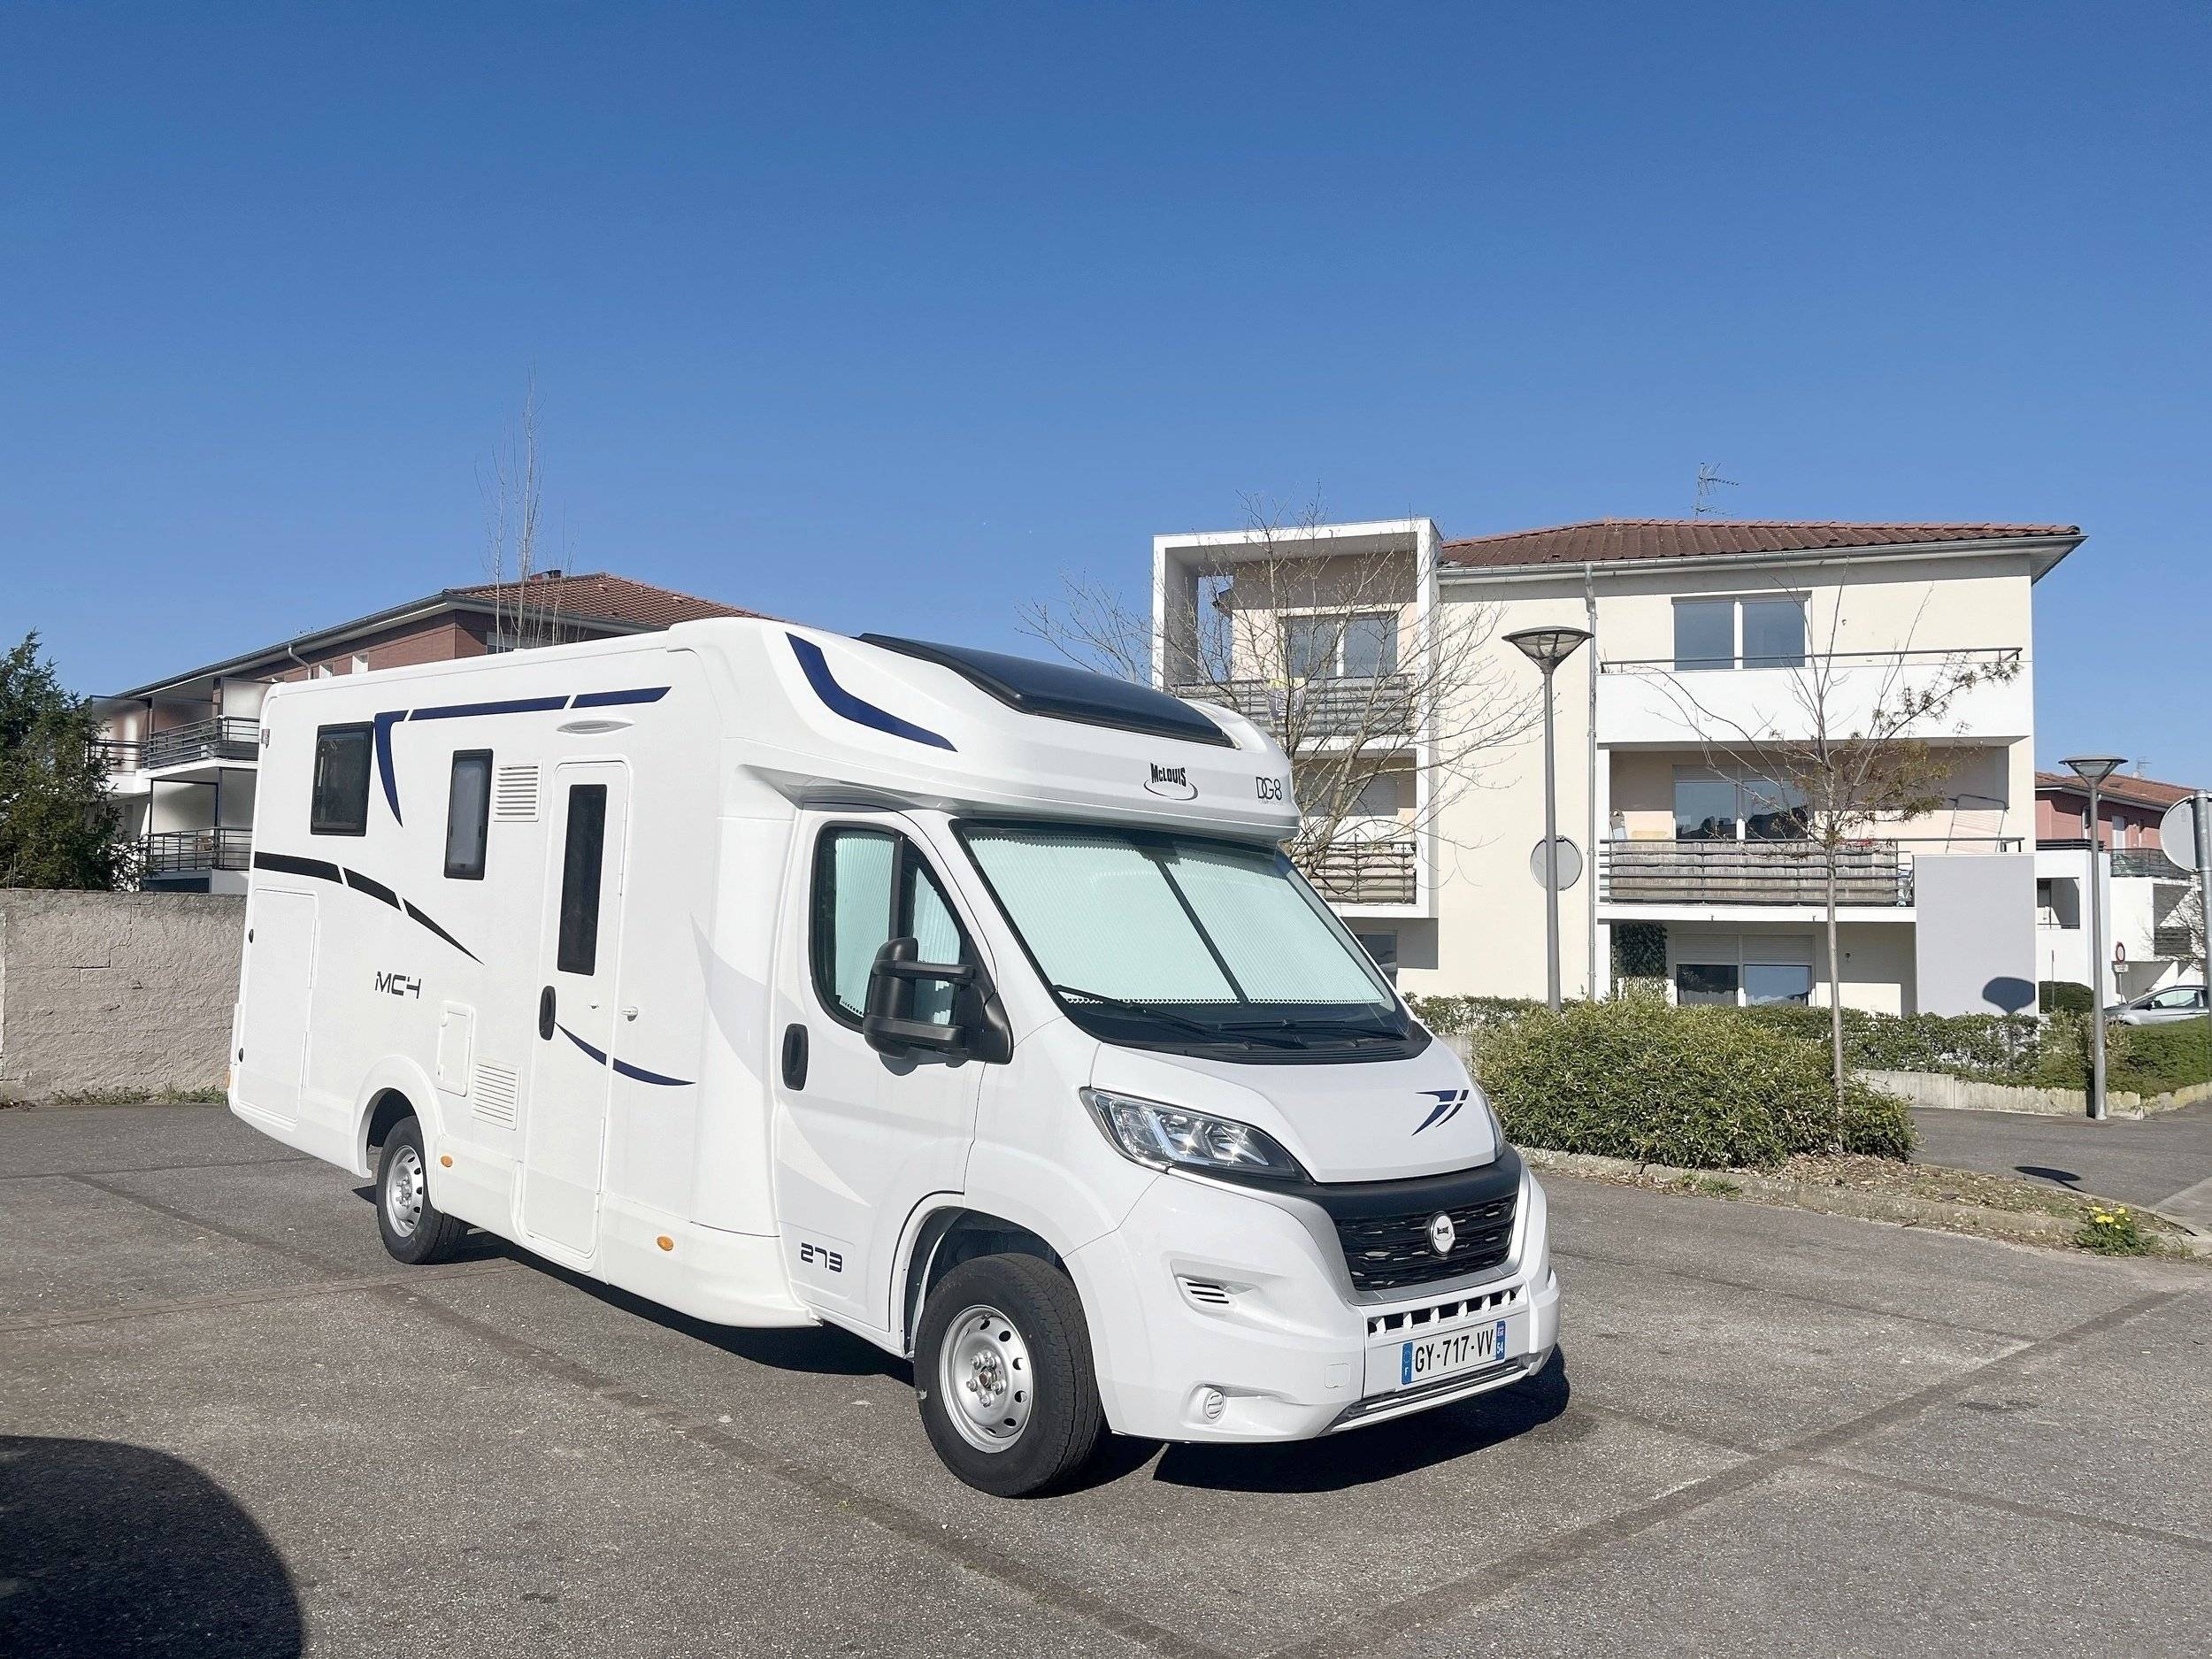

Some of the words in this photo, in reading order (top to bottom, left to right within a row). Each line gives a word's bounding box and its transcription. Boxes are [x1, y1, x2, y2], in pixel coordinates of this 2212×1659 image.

[1256, 776, 1283, 801] DG8
[800, 1241, 843, 1273] 273
[1415, 1328, 1494, 1373] GY-717-VV
[1404, 1367, 1409, 1376] F
